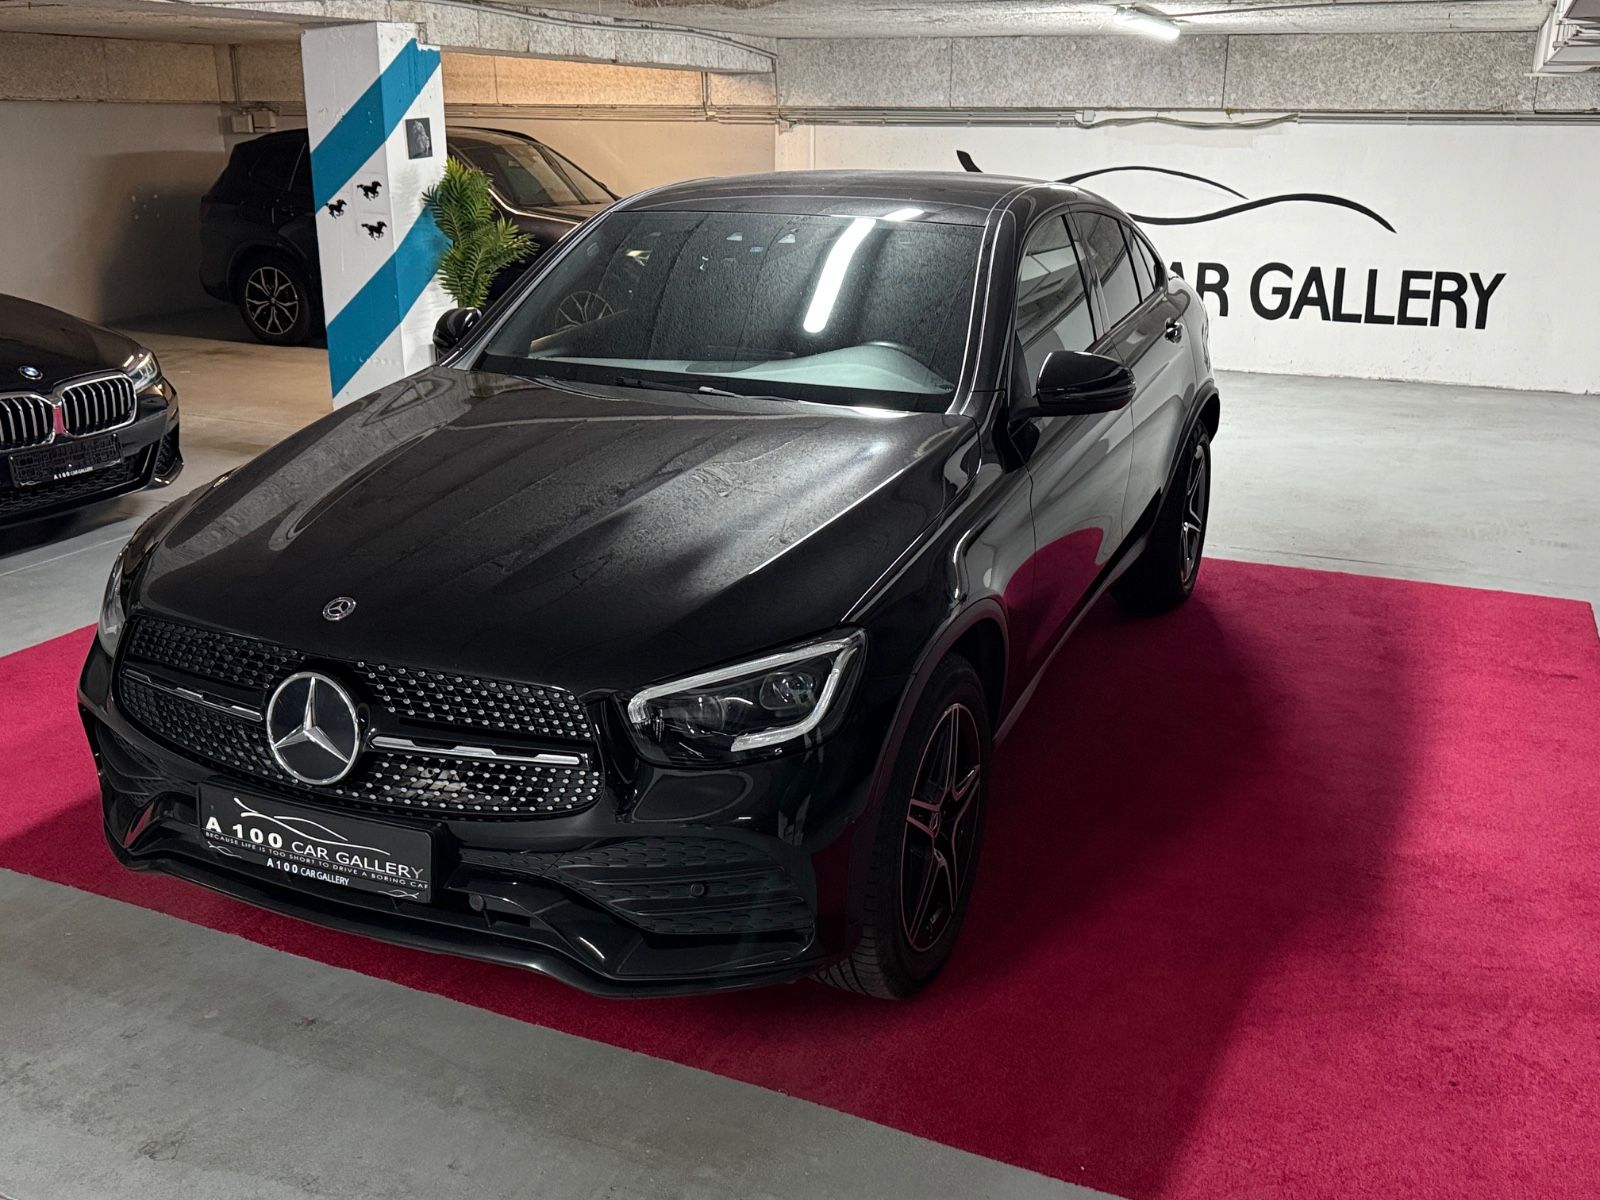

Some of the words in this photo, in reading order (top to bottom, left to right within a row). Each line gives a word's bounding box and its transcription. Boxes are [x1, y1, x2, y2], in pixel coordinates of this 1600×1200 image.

[1249, 261, 1507, 330] GALLERY
[205, 816, 222, 833] A
[232, 823, 283, 848] 100
[291, 841, 329, 860] CAR
[335, 851, 424, 880] GALLERY
[205, 832, 238, 845] BECAUSE
[241, 841, 256, 850] LIFE
[269, 847, 286, 858] TOO
[289, 854, 315, 865] SHORT
[318, 860, 330, 868] TO
[332, 864, 358, 875] DRIVE
[371, 873, 407, 885] BORING
[300, 867, 316, 879] CAR
[316, 871, 350, 886] GALLERY
